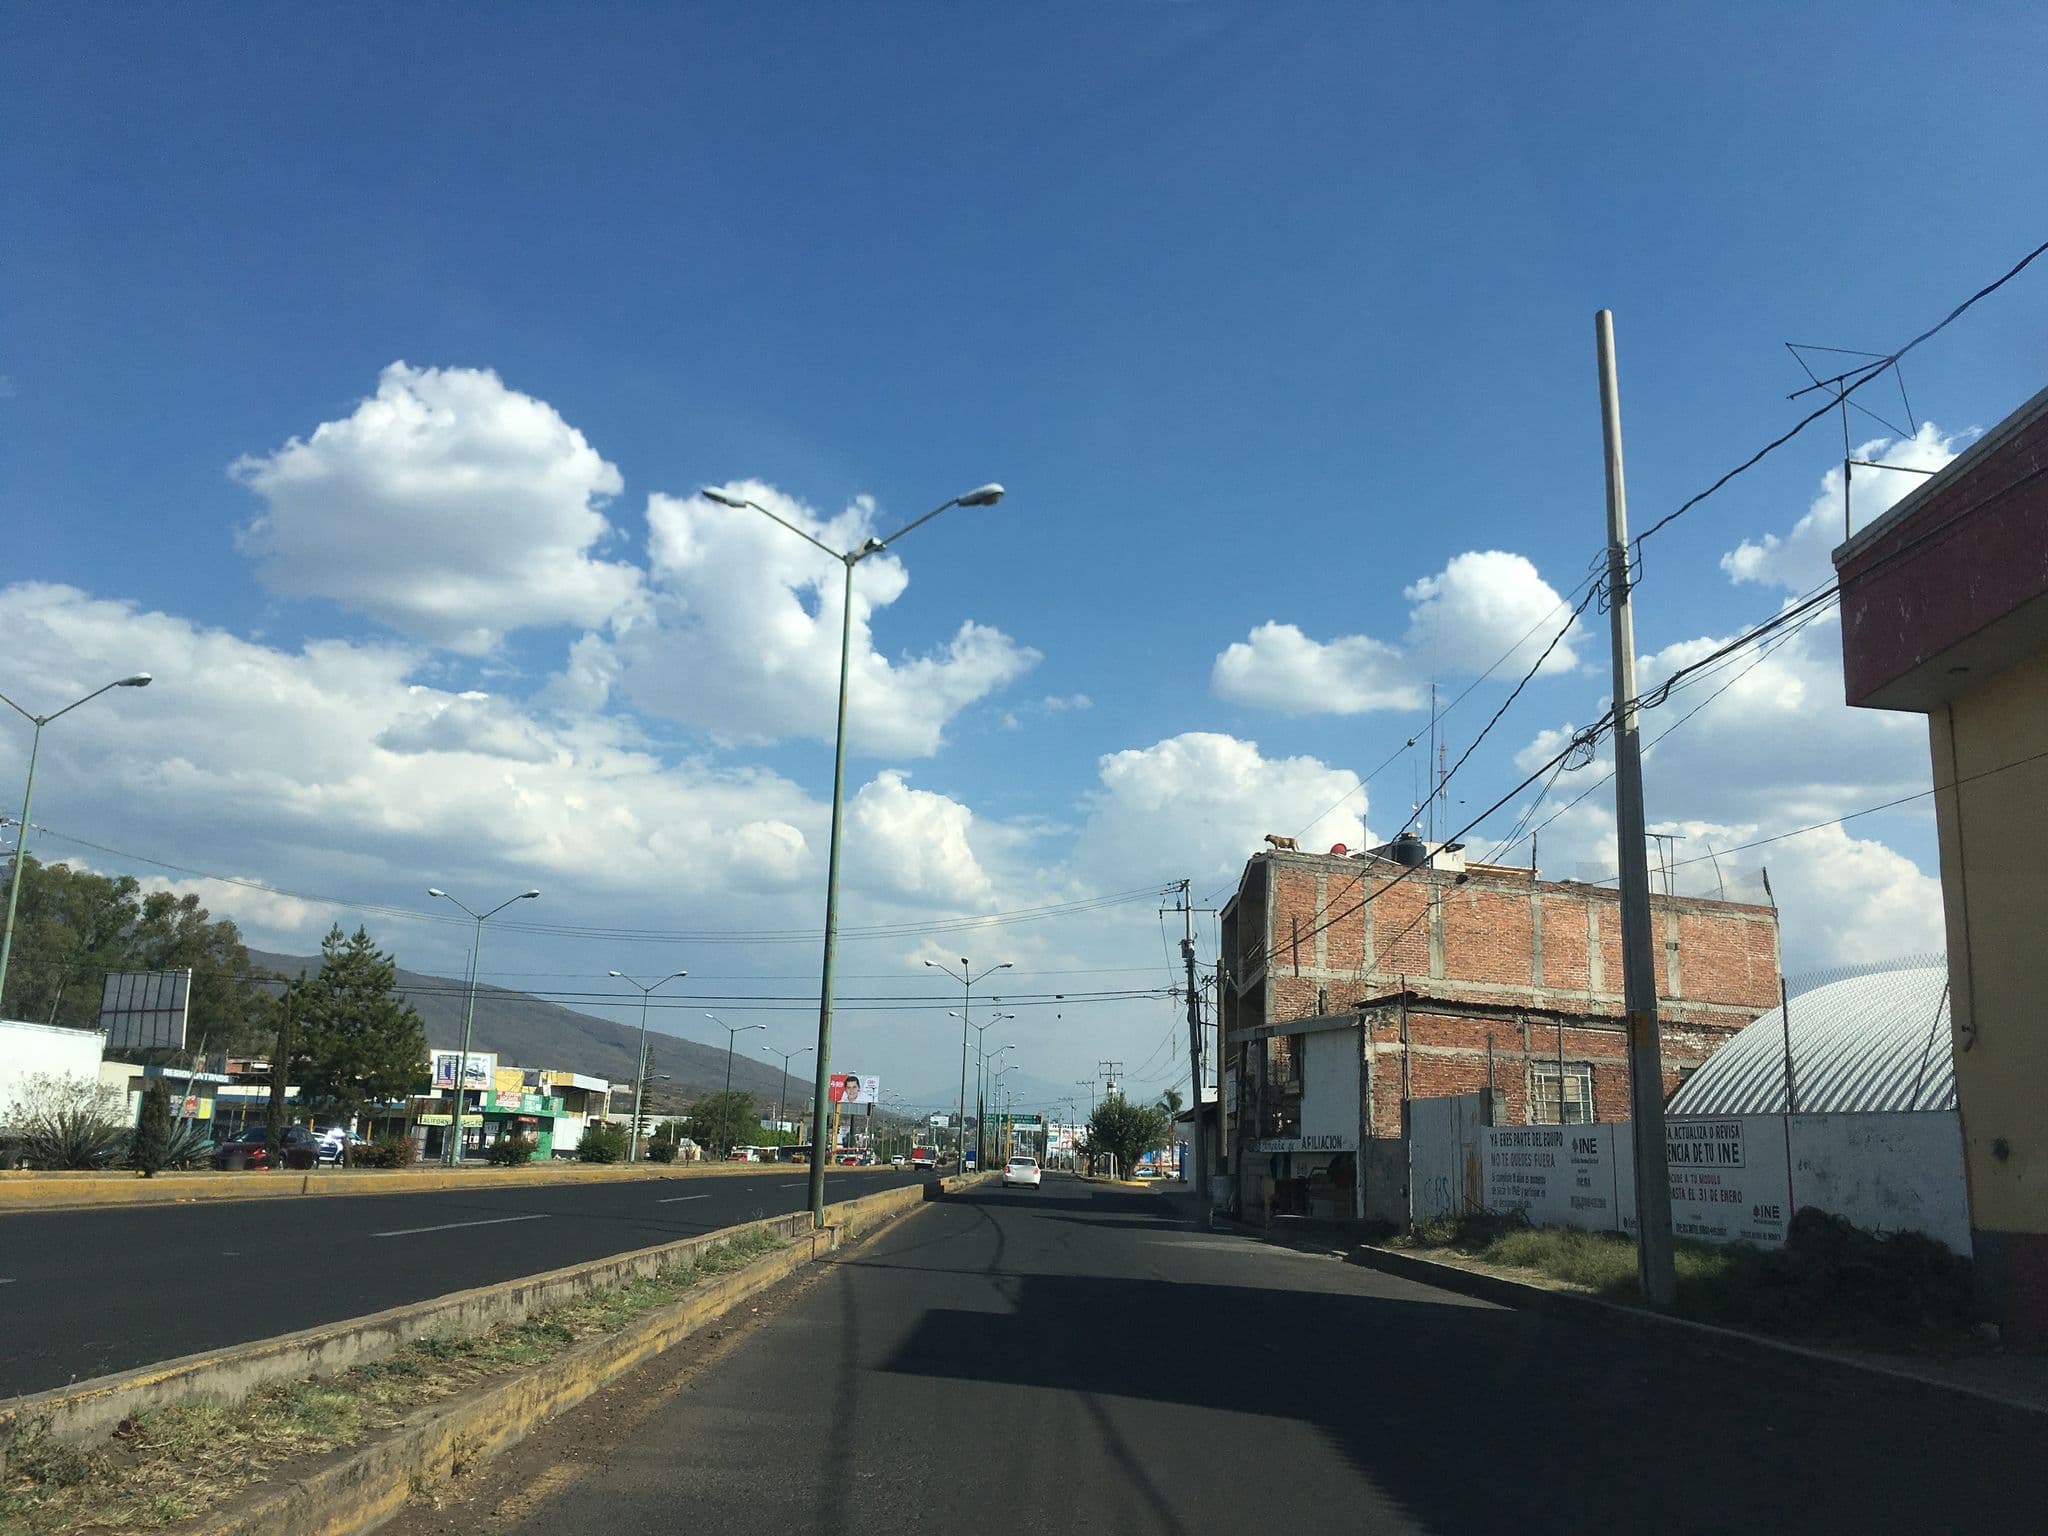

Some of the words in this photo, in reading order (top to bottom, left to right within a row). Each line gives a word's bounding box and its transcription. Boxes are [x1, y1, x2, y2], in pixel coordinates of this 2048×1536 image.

[1674, 1126, 1707, 1139] ACTUALIZA
[1716, 1125, 1740, 1139] REVISA
[1490, 1133, 1498, 1147] YA
[1514, 1132, 1531, 1147] PARTE
[1579, 1138, 1597, 1154] INE
[1667, 1143, 1690, 1162] ENCIA
[1693, 1143, 1702, 1163] DE
[1704, 1143, 1714, 1162] TU
[1718, 1143, 1739, 1163] INE
[1688, 1188, 1695, 1201] EL
[1699, 1188, 1707, 1201] 31
[1710, 1189, 1718, 1202] DE
[1761, 1206, 1780, 1219] INE
